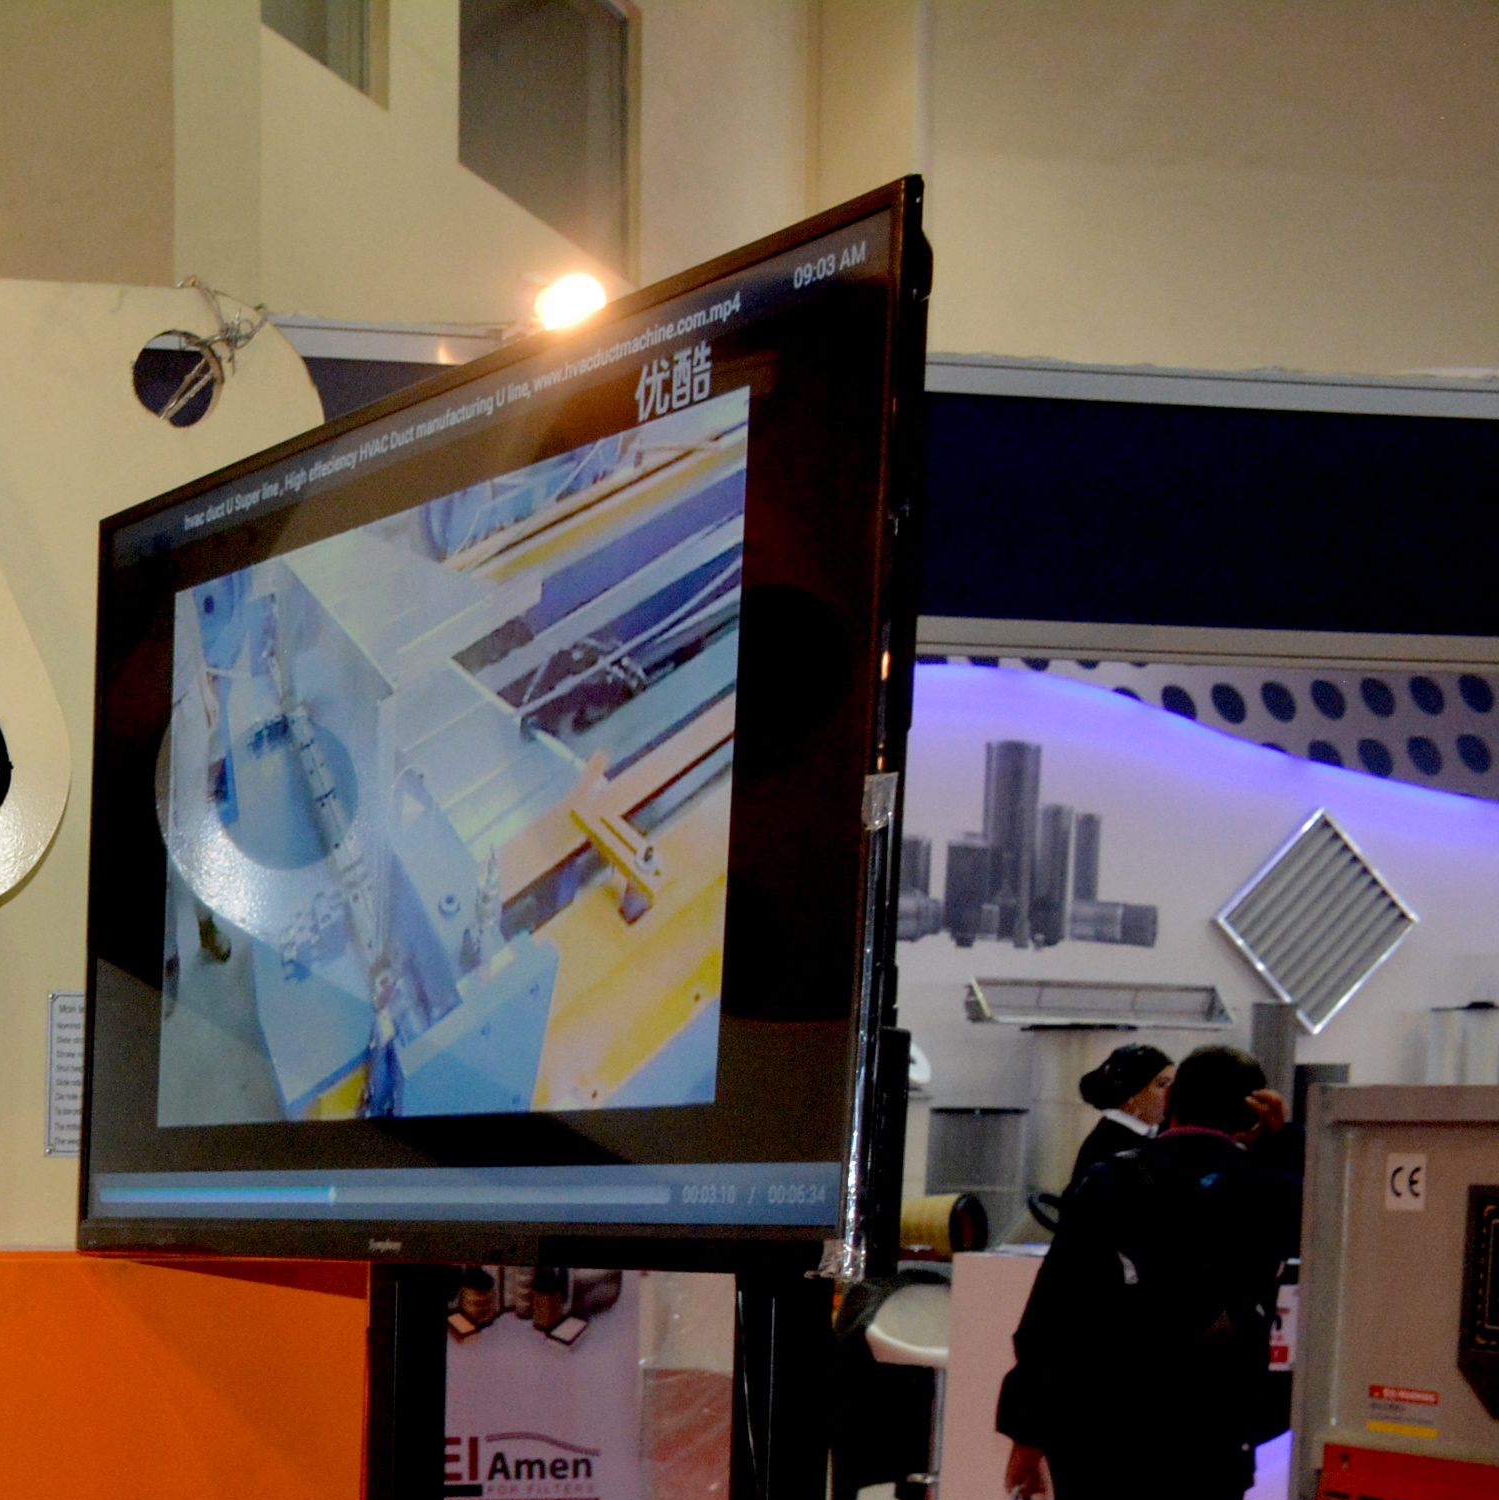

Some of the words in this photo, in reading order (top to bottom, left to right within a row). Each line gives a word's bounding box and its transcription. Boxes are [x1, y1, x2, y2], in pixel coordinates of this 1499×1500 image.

[793, 252, 837, 290] 09:03
[838, 239, 867, 272] AM
[205, 501, 226, 523] duct
[225, 498, 235, 515] U
[234, 489, 261, 514] Super
[284, 468, 307, 492] High
[307, 449, 359, 483] effeciency
[359, 437, 389, 462] HVAC
[389, 424, 415, 451] Duct
[415, 392, 495, 440] manufacturing
[495, 390, 505, 409] U
[505, 380, 531, 406] line,
[533, 290, 742, 392] www.hvacductmachine.com.mp4
[634, 340, 713, 423] 优酷
[488, 1452, 593, 1482] Amen
